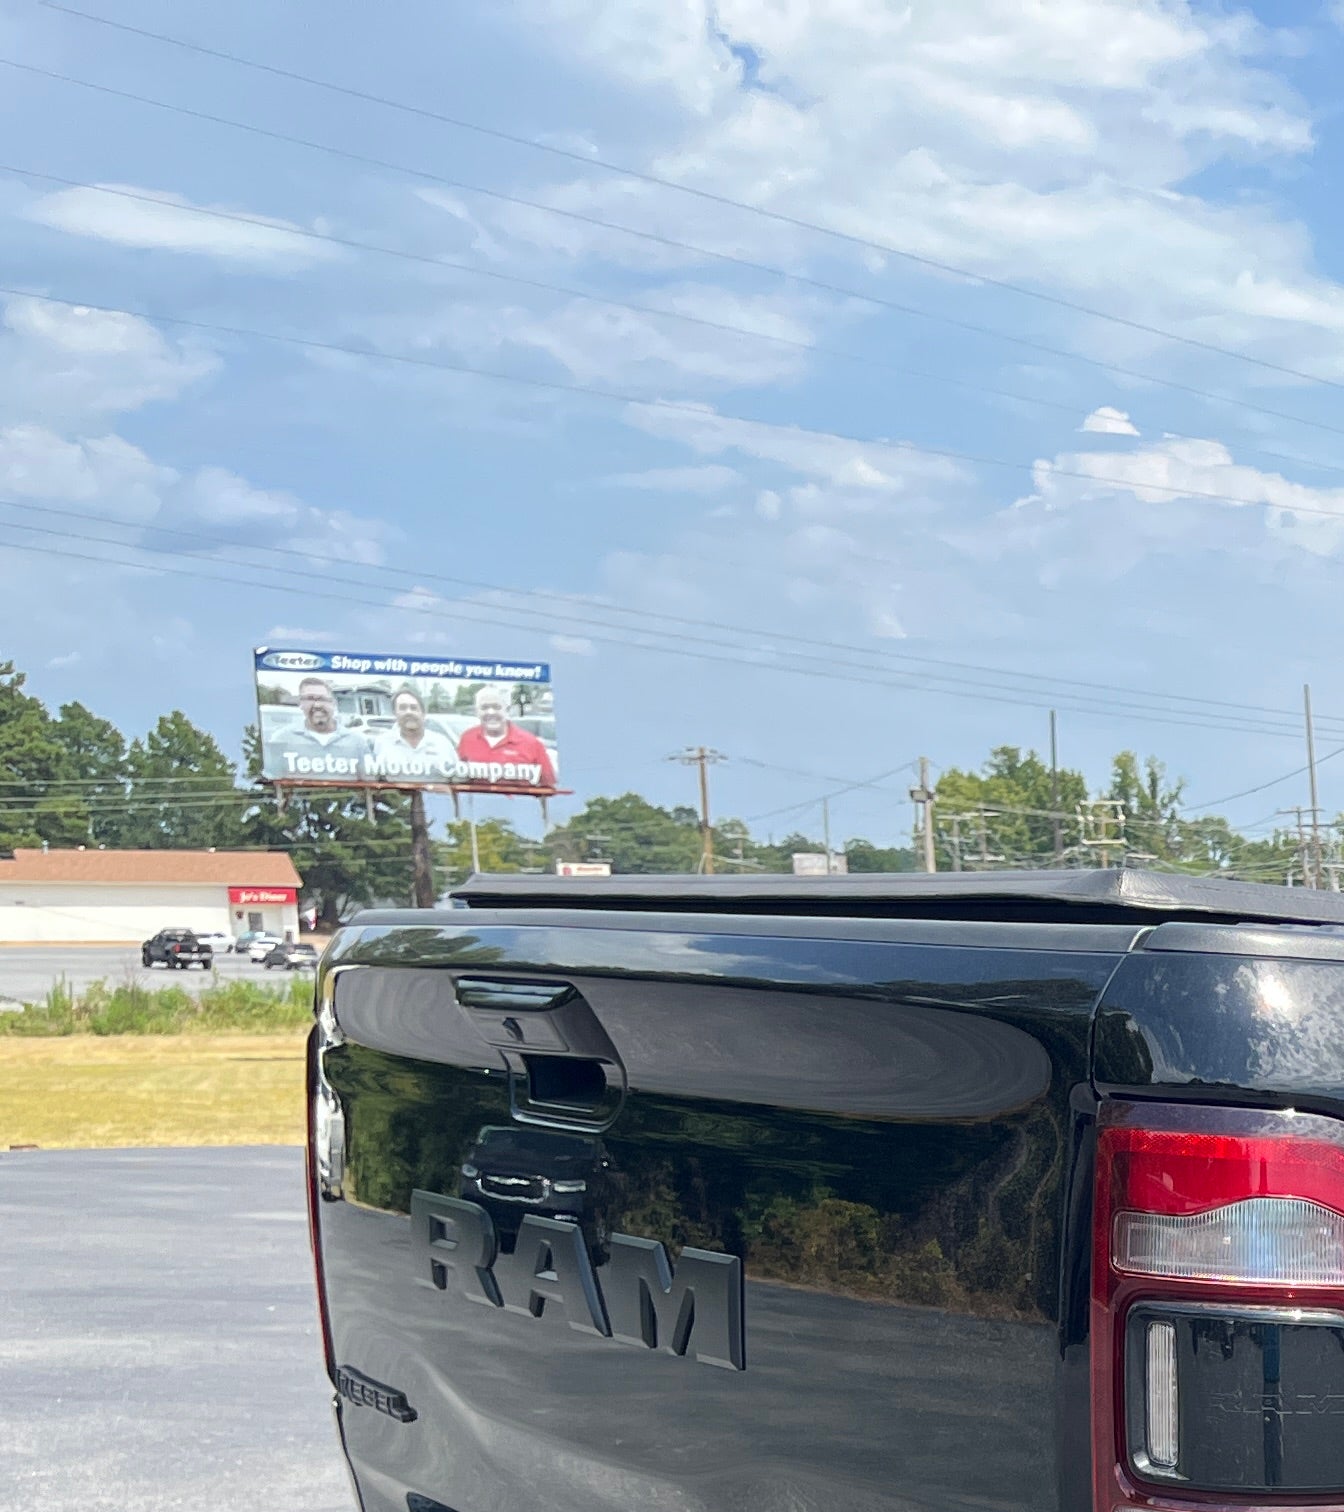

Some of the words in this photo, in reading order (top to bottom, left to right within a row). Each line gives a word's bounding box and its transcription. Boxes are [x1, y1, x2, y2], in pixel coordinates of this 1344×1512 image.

[331, 656, 372, 672] Shop
[374, 658, 408, 672] with
[410, 660, 463, 676] people
[465, 663, 493, 678] you
[495, 664, 542, 680] know!
[283, 752, 359, 774] Teeter
[363, 754, 433, 777] Motor
[440, 760, 543, 786] Company
[410, 1187, 748, 1372] RAM
